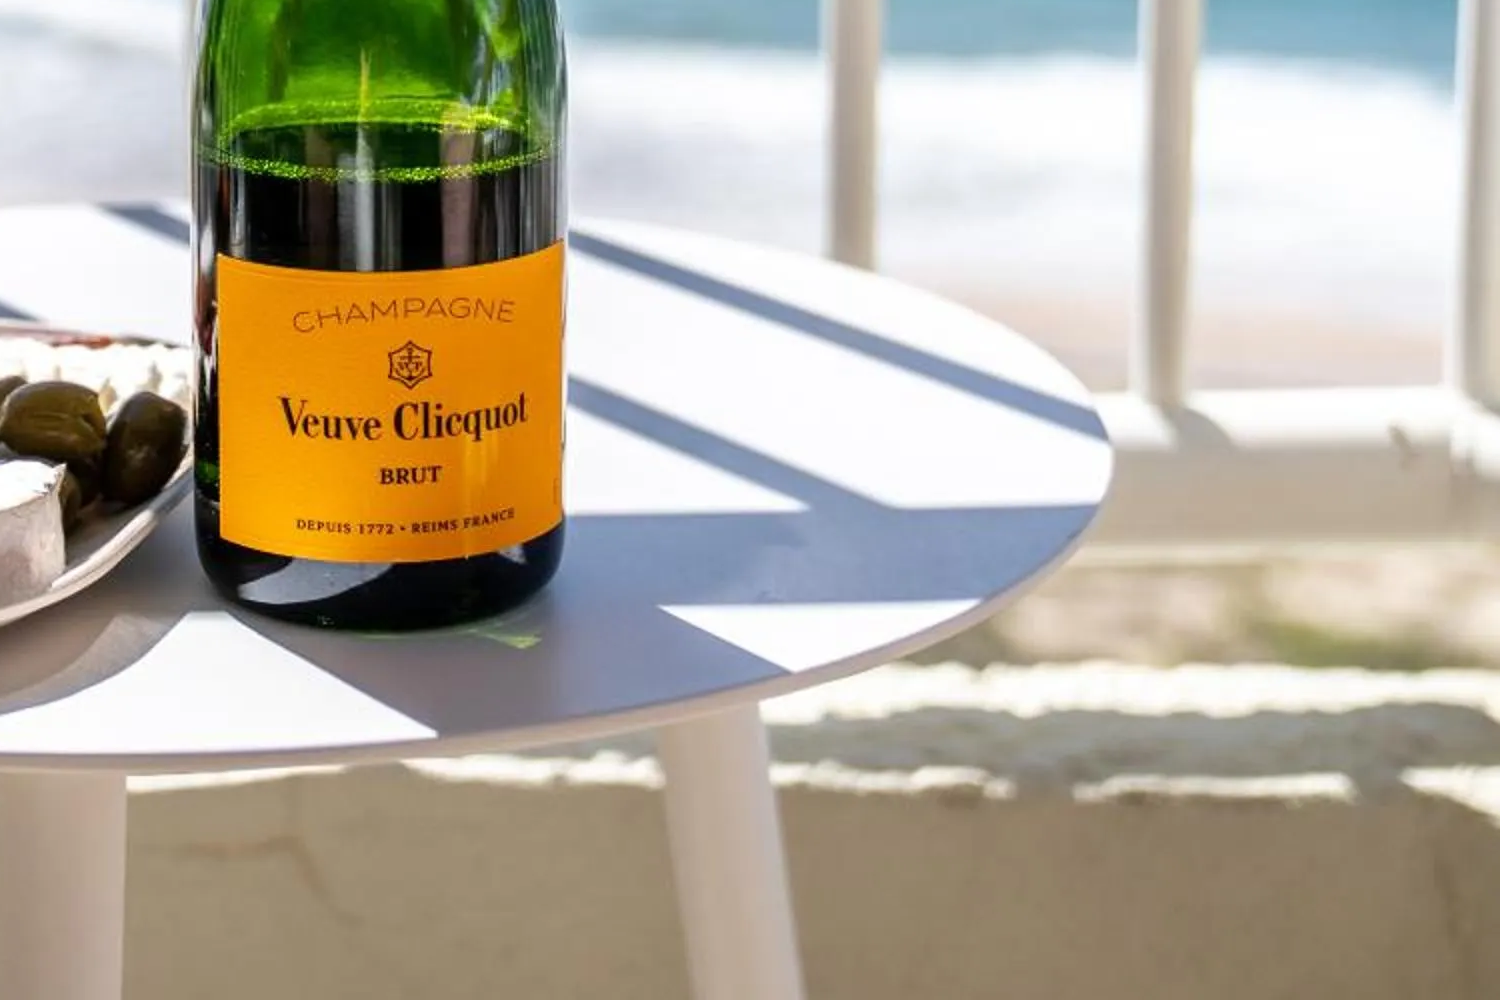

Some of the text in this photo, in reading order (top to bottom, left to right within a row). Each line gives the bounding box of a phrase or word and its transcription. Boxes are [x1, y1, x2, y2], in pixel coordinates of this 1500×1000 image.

[293, 297, 514, 333] CHAMPAGNE
[278, 392, 527, 442] Veuve Clicquot
[380, 466, 442, 485] BRUT
[297, 507, 515, 535] DEPUIS 1772 REIMS FRANCE
